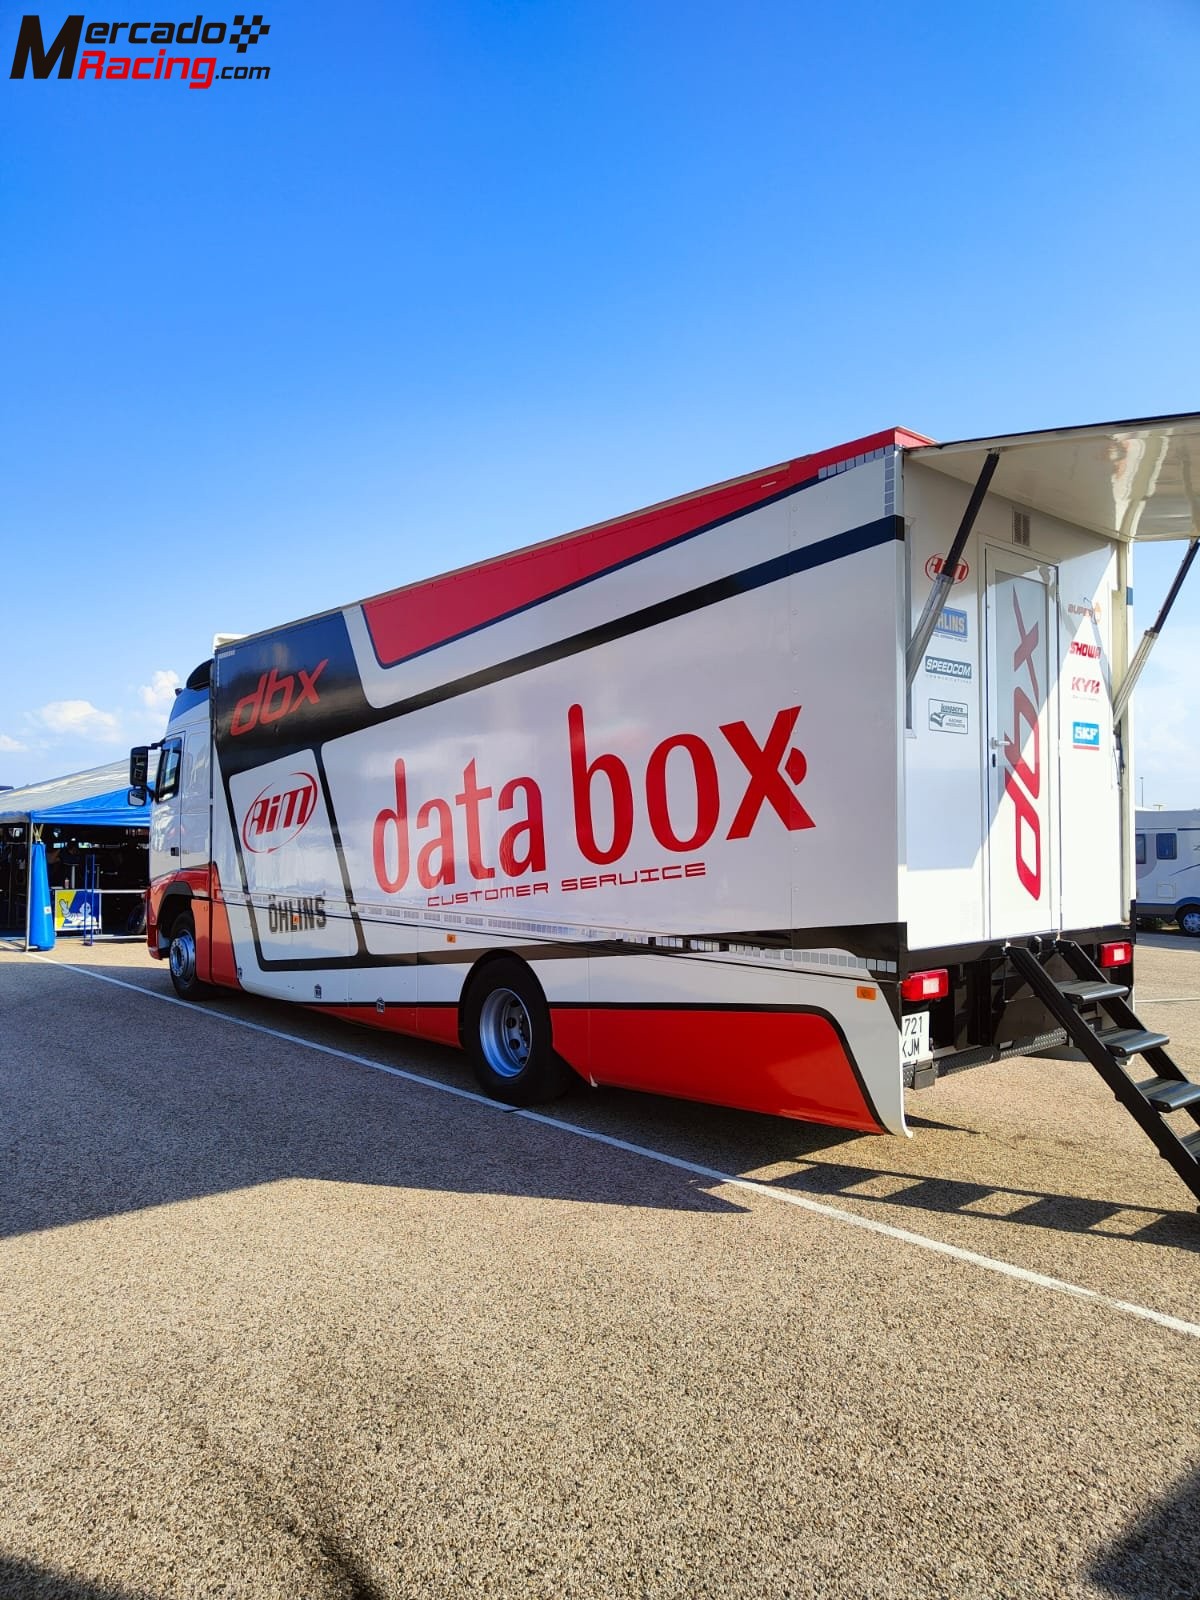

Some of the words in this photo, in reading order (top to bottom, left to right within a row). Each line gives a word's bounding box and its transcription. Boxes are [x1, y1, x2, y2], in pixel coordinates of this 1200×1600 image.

[934, 611, 965, 634] HLINS
[1070, 641, 1102, 659] SHOWA
[926, 658, 971, 677] SPEEDCOM
[230, 658, 329, 737] dbx
[1074, 726, 1098, 741] SKF
[372, 757, 547, 895] data
[567, 703, 817, 865] box
[427, 882, 549, 907] CUSTOMER
